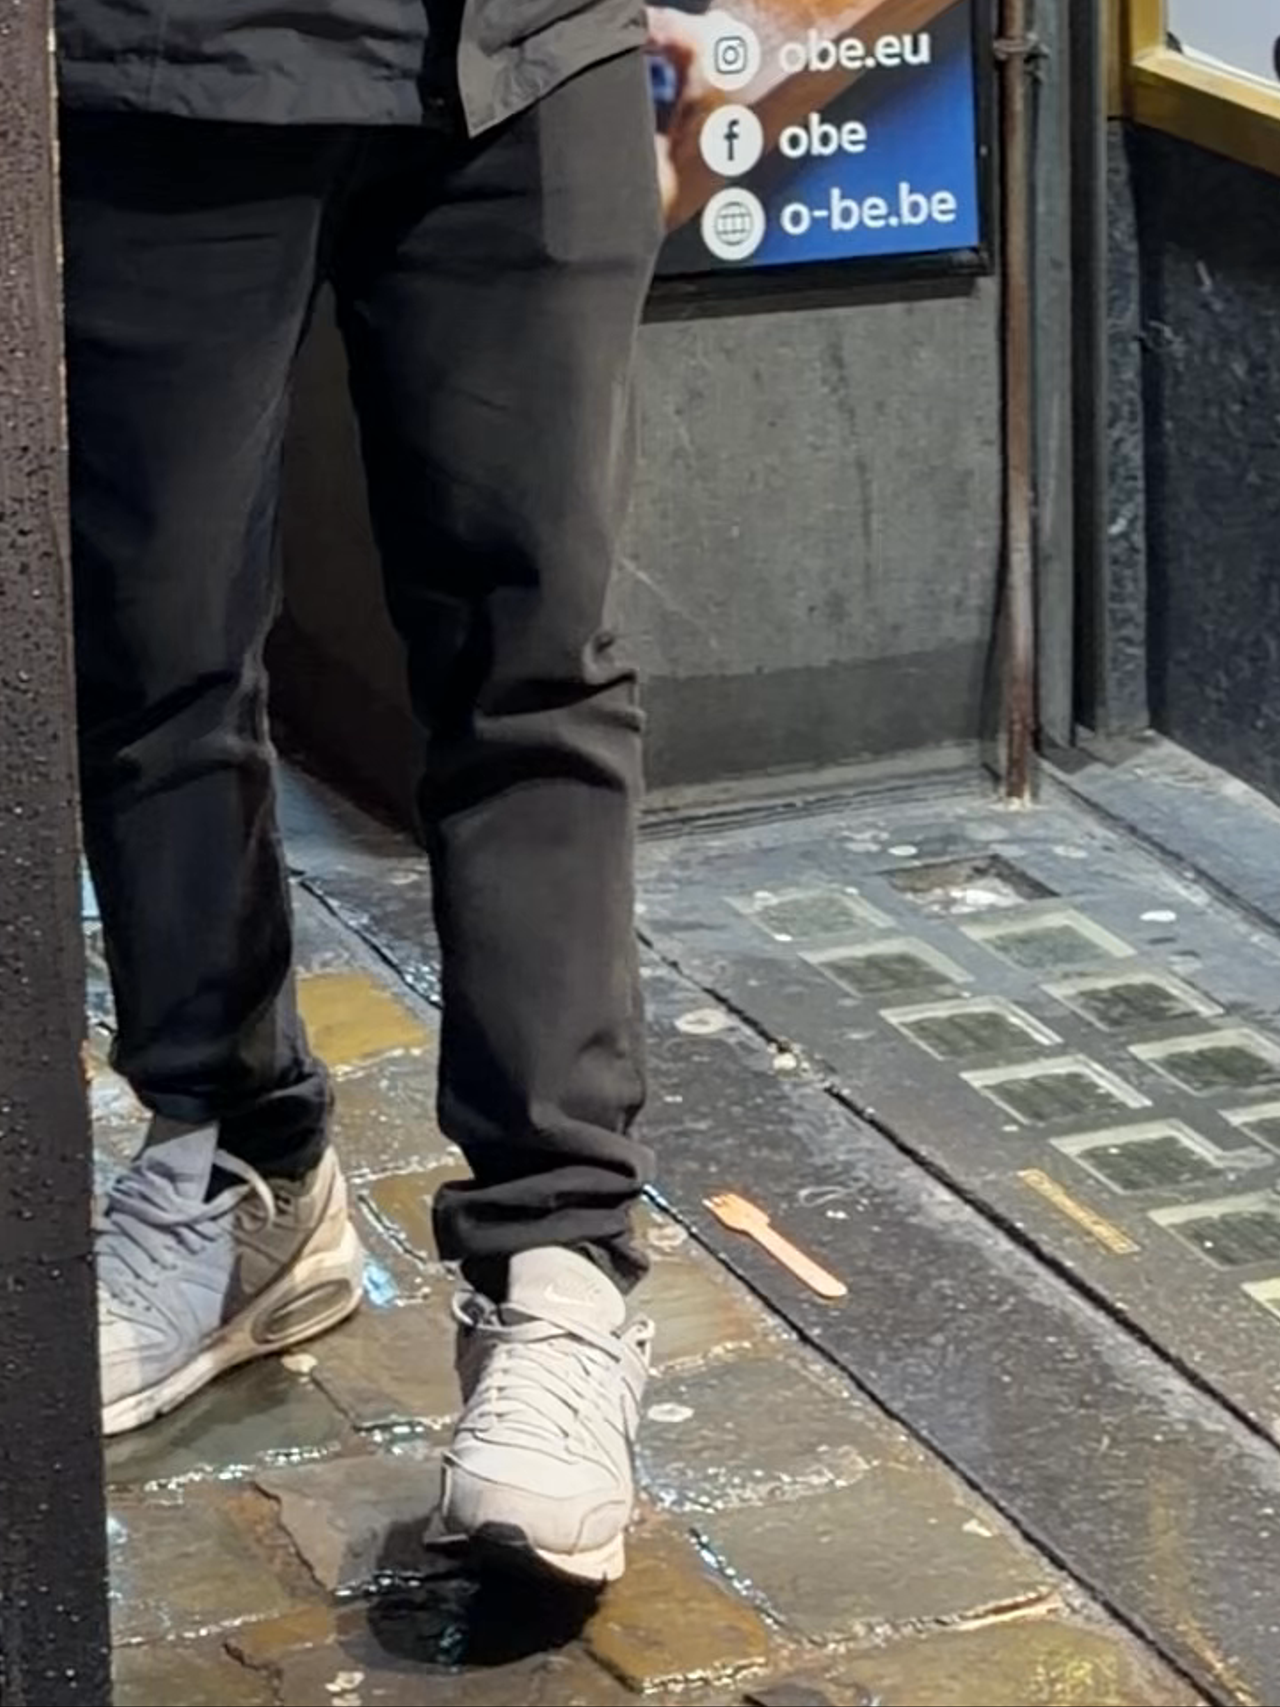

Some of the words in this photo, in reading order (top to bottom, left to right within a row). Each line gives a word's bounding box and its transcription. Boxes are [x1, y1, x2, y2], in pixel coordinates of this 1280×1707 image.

[778, 28, 931, 73] obe.eu
[778, 112, 868, 159] obe
[780, 181, 958, 235] o-be.be
